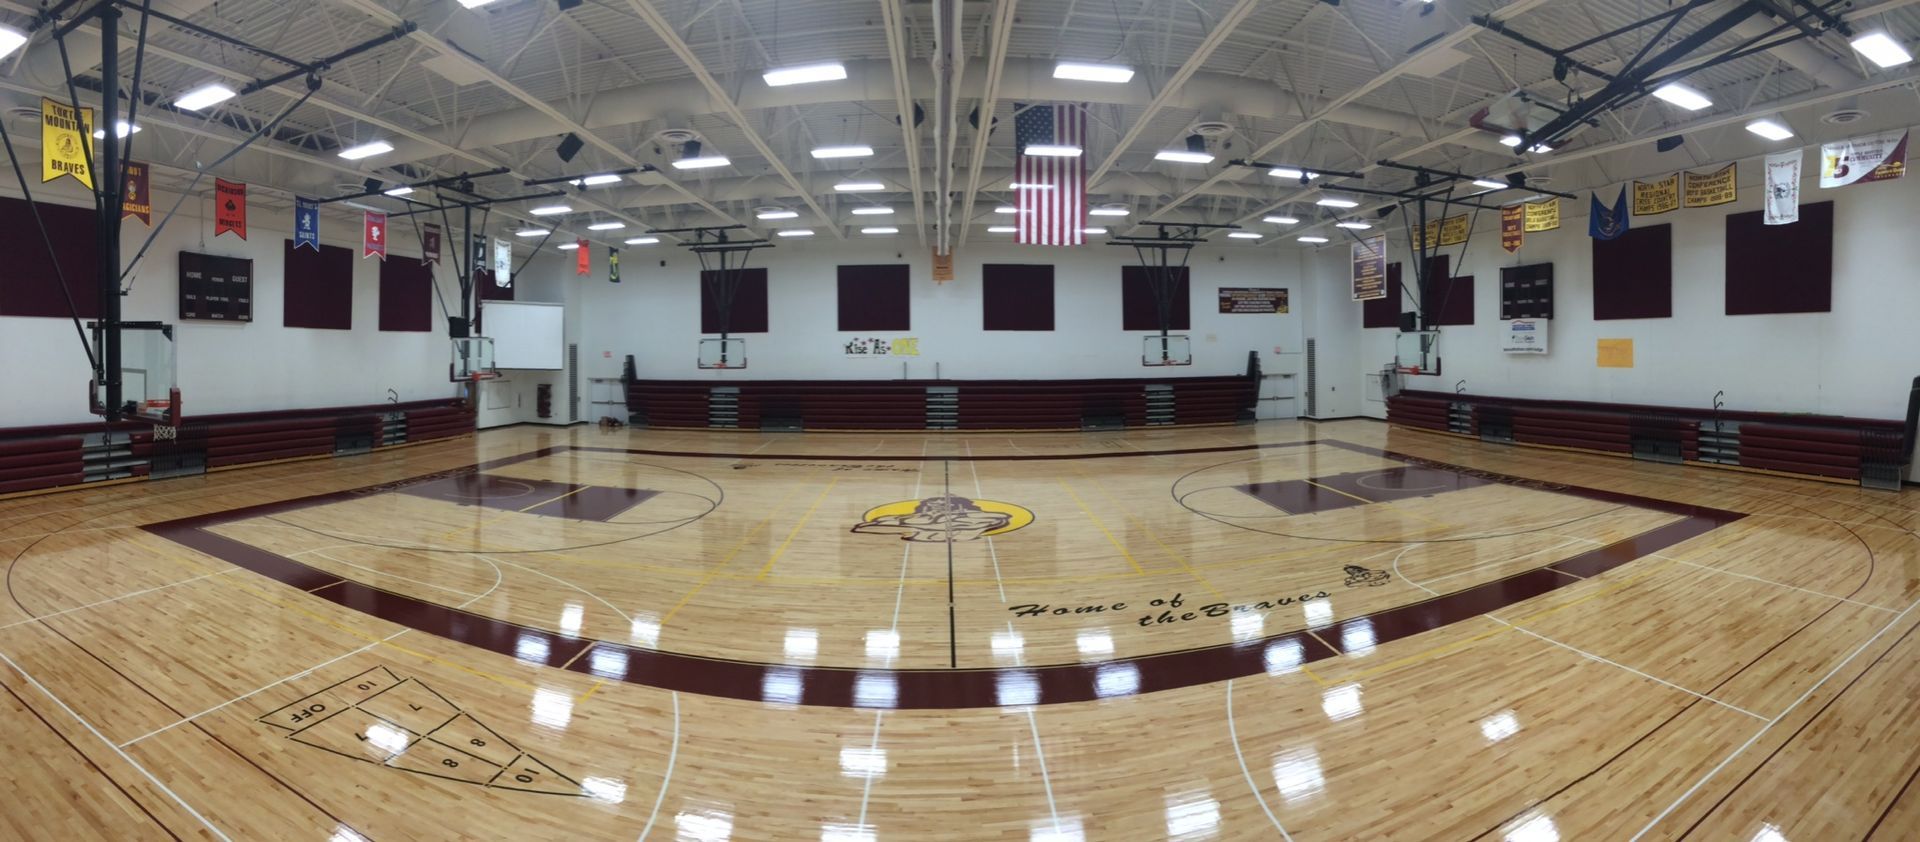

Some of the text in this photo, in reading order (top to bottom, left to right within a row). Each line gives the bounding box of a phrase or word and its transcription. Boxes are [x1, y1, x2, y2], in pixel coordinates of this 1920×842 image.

[52, 105, 82, 117] TURT
[51, 159, 85, 175] BRAVES
[1687, 175, 1731, 189] CONFERENCE
[845, 341, 868, 354] Rise
[892, 337, 920, 356] ONE
[1008, 592, 1185, 618] Home of
[1138, 590, 1332, 627] the Braves
[291, 680, 377, 723] 10 OFF
[408, 703, 423, 712] 7
[470, 738, 486, 747] 8
[442, 758, 459, 768] 8
[515, 768, 540, 784] 10
